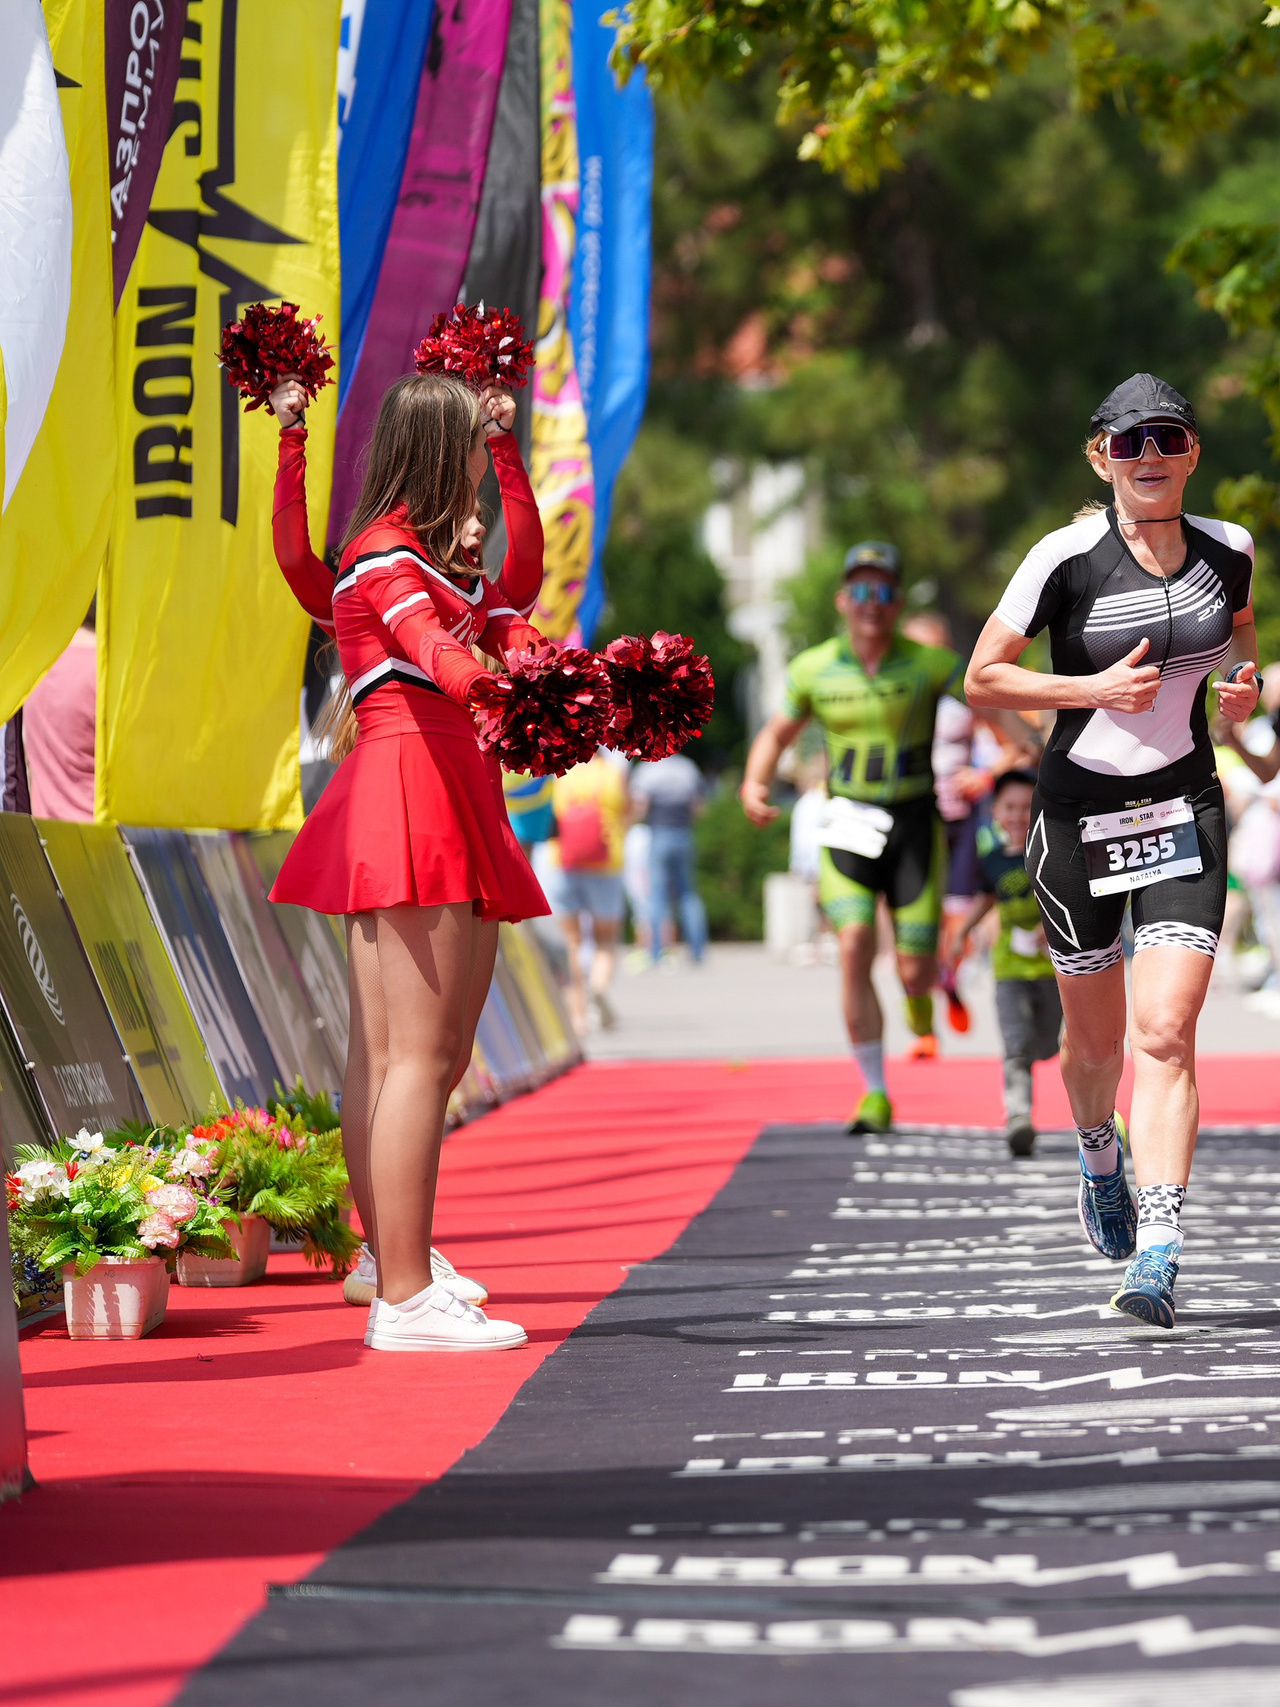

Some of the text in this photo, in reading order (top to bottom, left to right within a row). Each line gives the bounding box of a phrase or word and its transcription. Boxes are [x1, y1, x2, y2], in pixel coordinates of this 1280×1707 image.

[133, 286, 197, 520] IRON
[1197, 591, 1227, 622] 2XU
[1119, 811, 1155, 825] IRON STAR
[1106, 832, 1176, 871] 3255
[1130, 869, 1161, 883] NATALYA
[766, 1303, 1039, 1320] IRON
[732, 1369, 1041, 1387] IRON
[682, 1450, 1041, 1472] IRON
[606, 1552, 1039, 1581] IRON
[561, 1613, 1037, 1647] IRON
